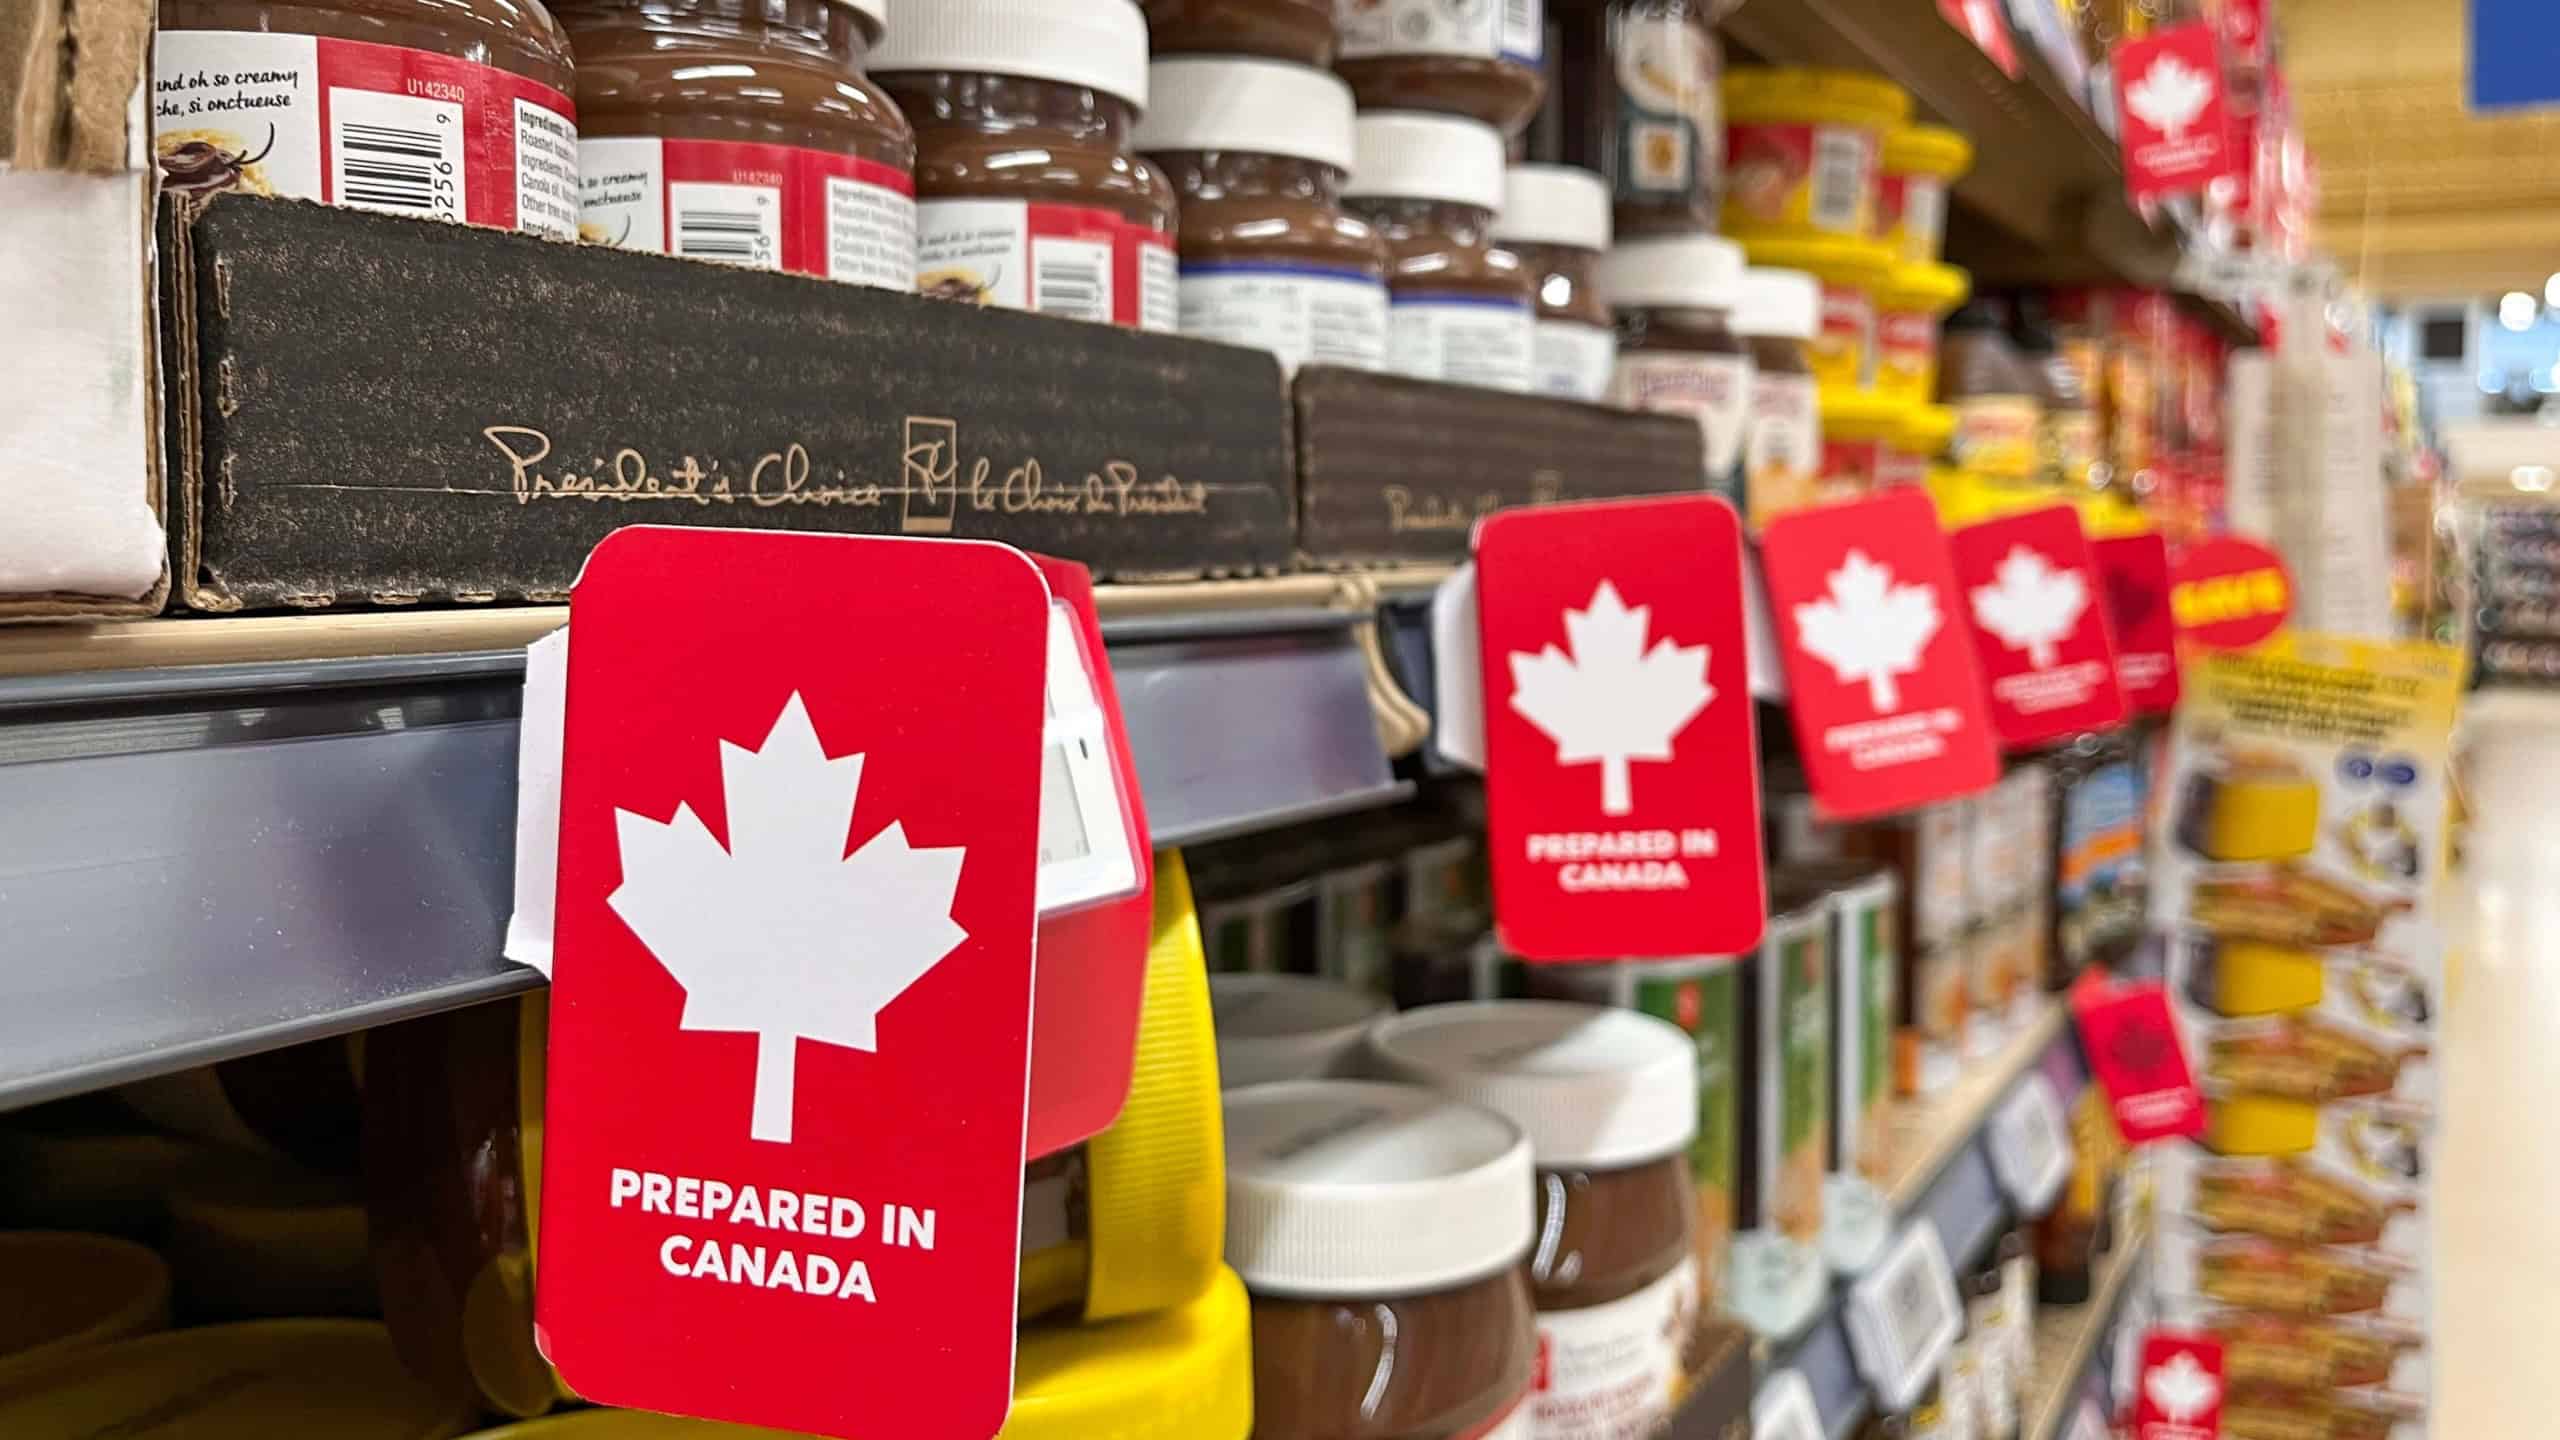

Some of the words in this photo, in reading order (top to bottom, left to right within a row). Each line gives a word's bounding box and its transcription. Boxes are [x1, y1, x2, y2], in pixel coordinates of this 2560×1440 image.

[189, 69, 209, 88] oh
[213, 74, 230, 87] so
[234, 70, 298, 89] creamy
[407, 78, 464, 101] U142340
[188, 96, 203, 114] si
[207, 91, 291, 111] onctueuse
[751, 443, 881, 506] Choice
[1526, 828, 1679, 863] PREPARED
[1680, 827, 1719, 858] IN
[1558, 860, 1690, 893] CANADA
[610, 1167, 866, 1240] PREPARED
[881, 1203, 936, 1250] IN
[659, 1234, 877, 1303] CANADA
